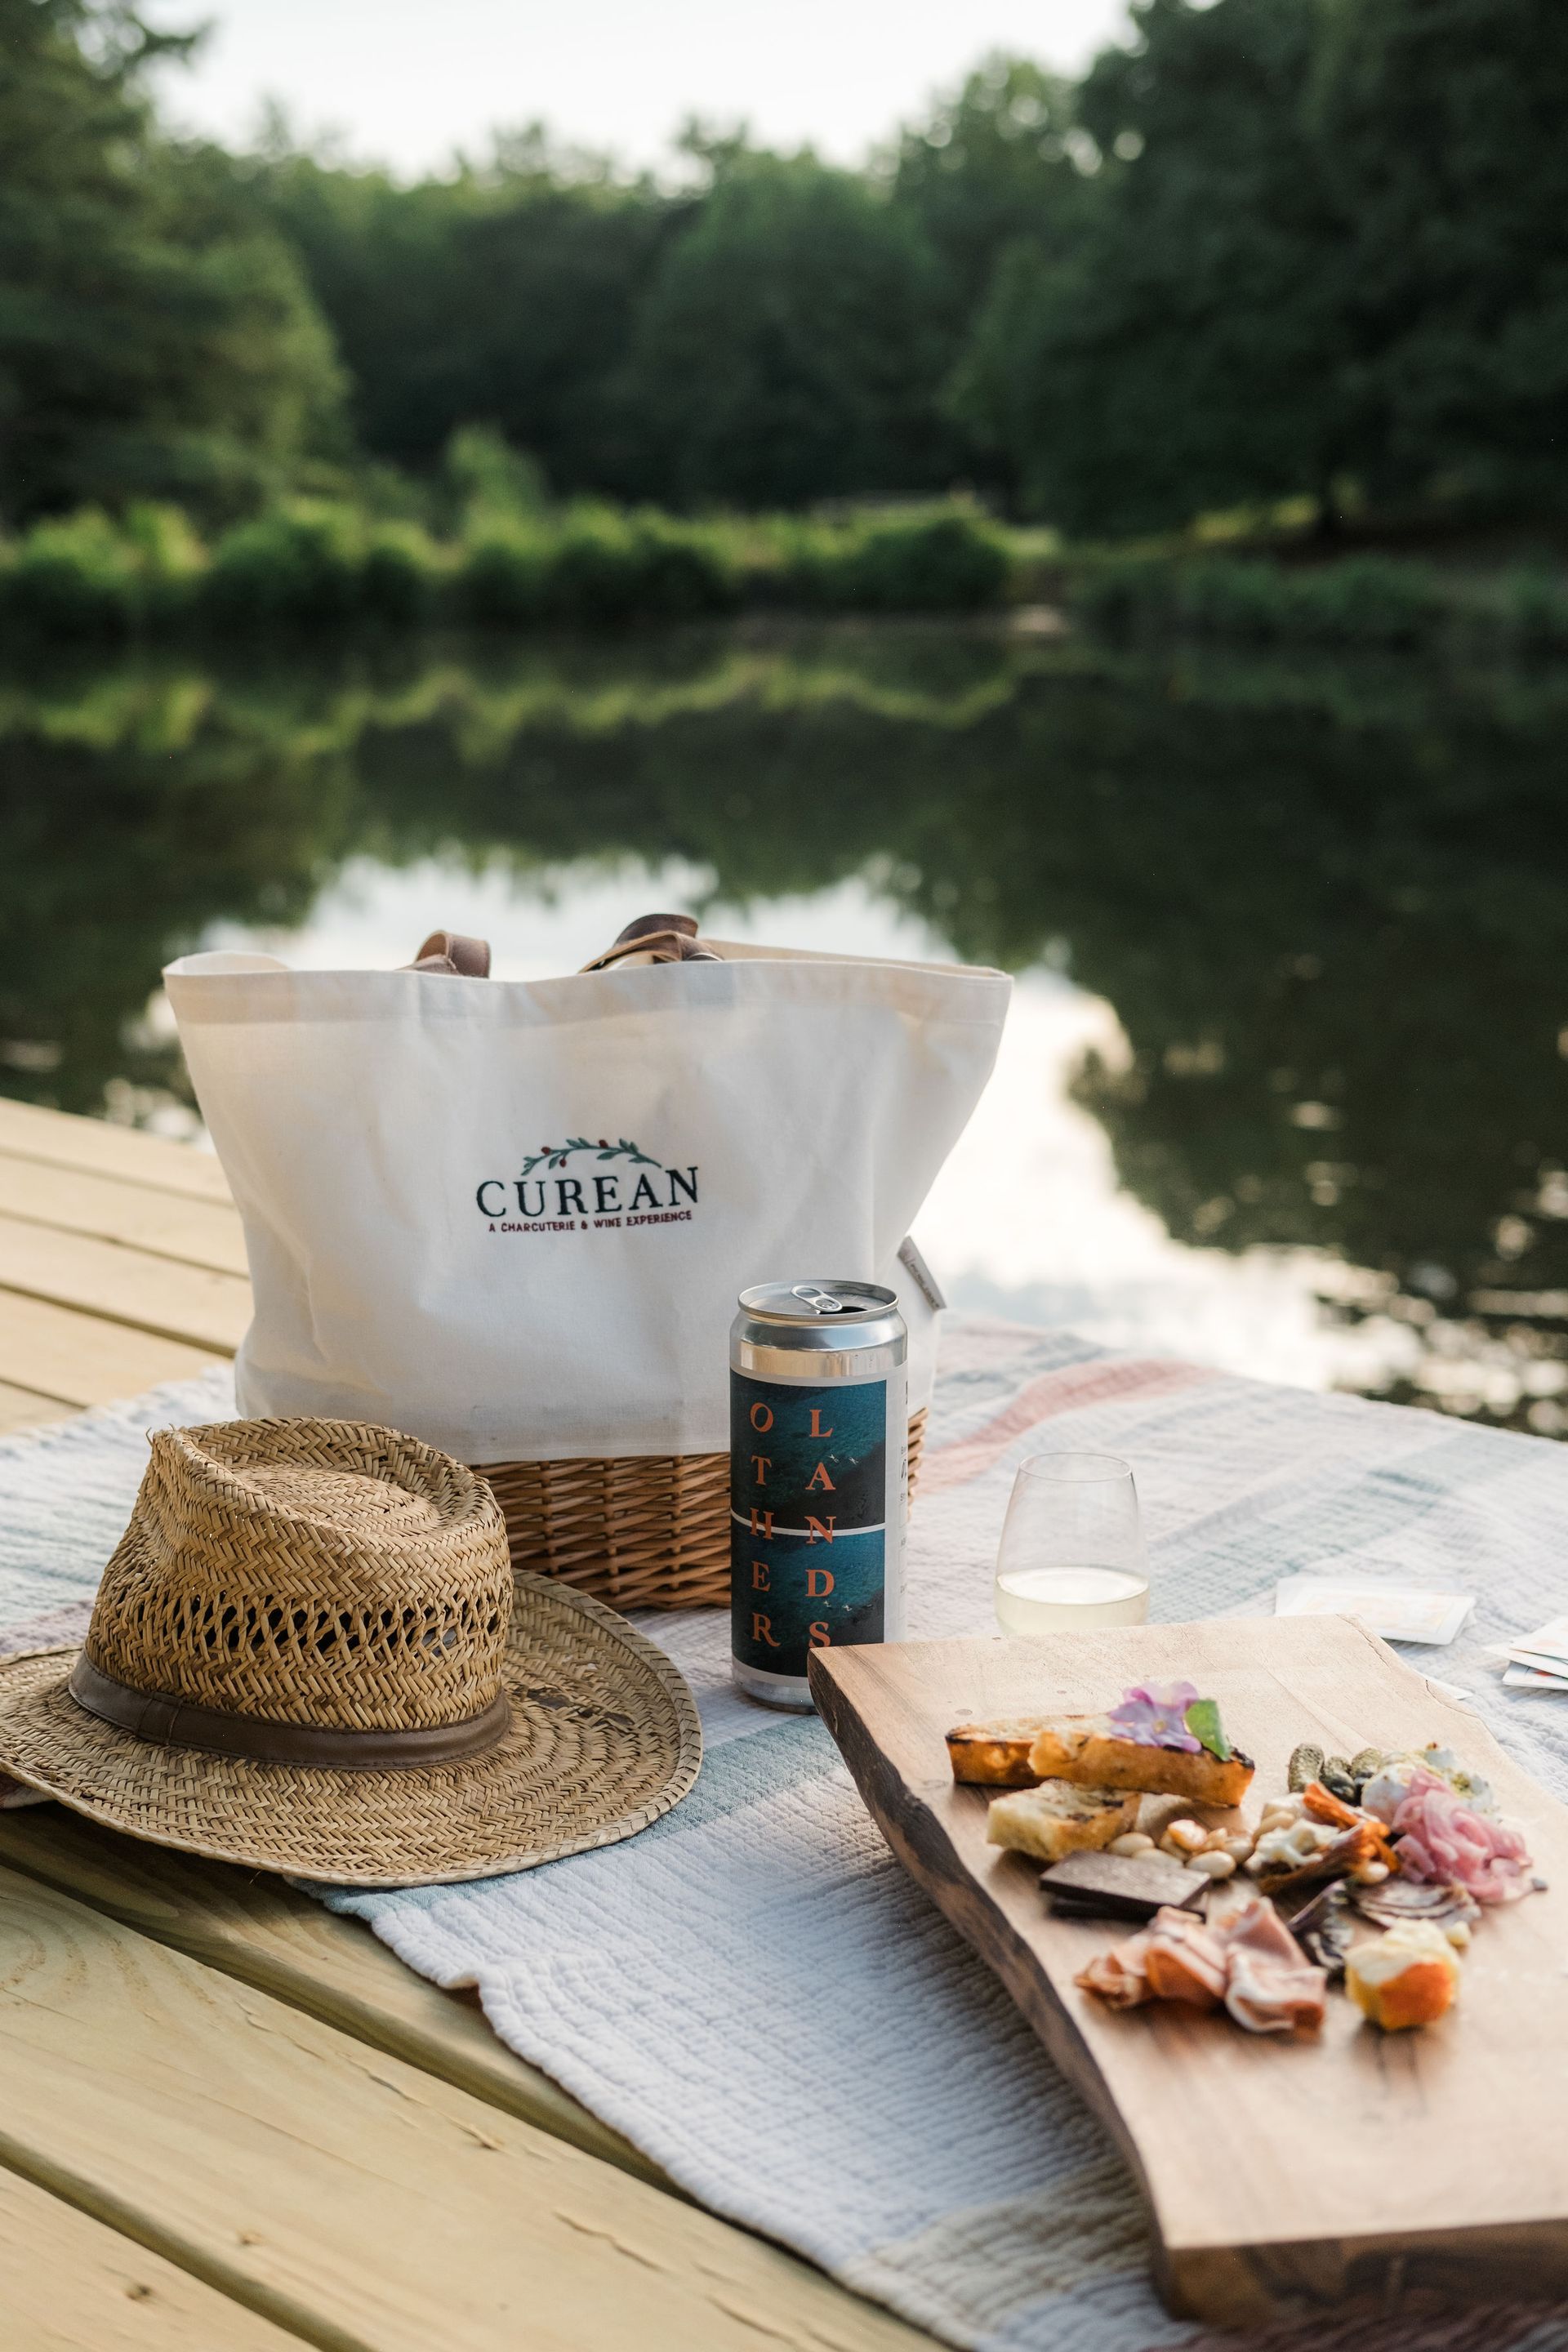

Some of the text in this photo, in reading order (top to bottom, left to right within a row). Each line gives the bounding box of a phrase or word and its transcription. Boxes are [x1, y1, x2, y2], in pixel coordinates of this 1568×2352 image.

[476, 1166, 699, 1217] CUREAN
[488, 1210, 692, 1232] A CHARCUTERIE & WINE EXPERIENCE
[749, 1401, 781, 1647] OTHER
[805, 1409, 835, 1647] LANDS
